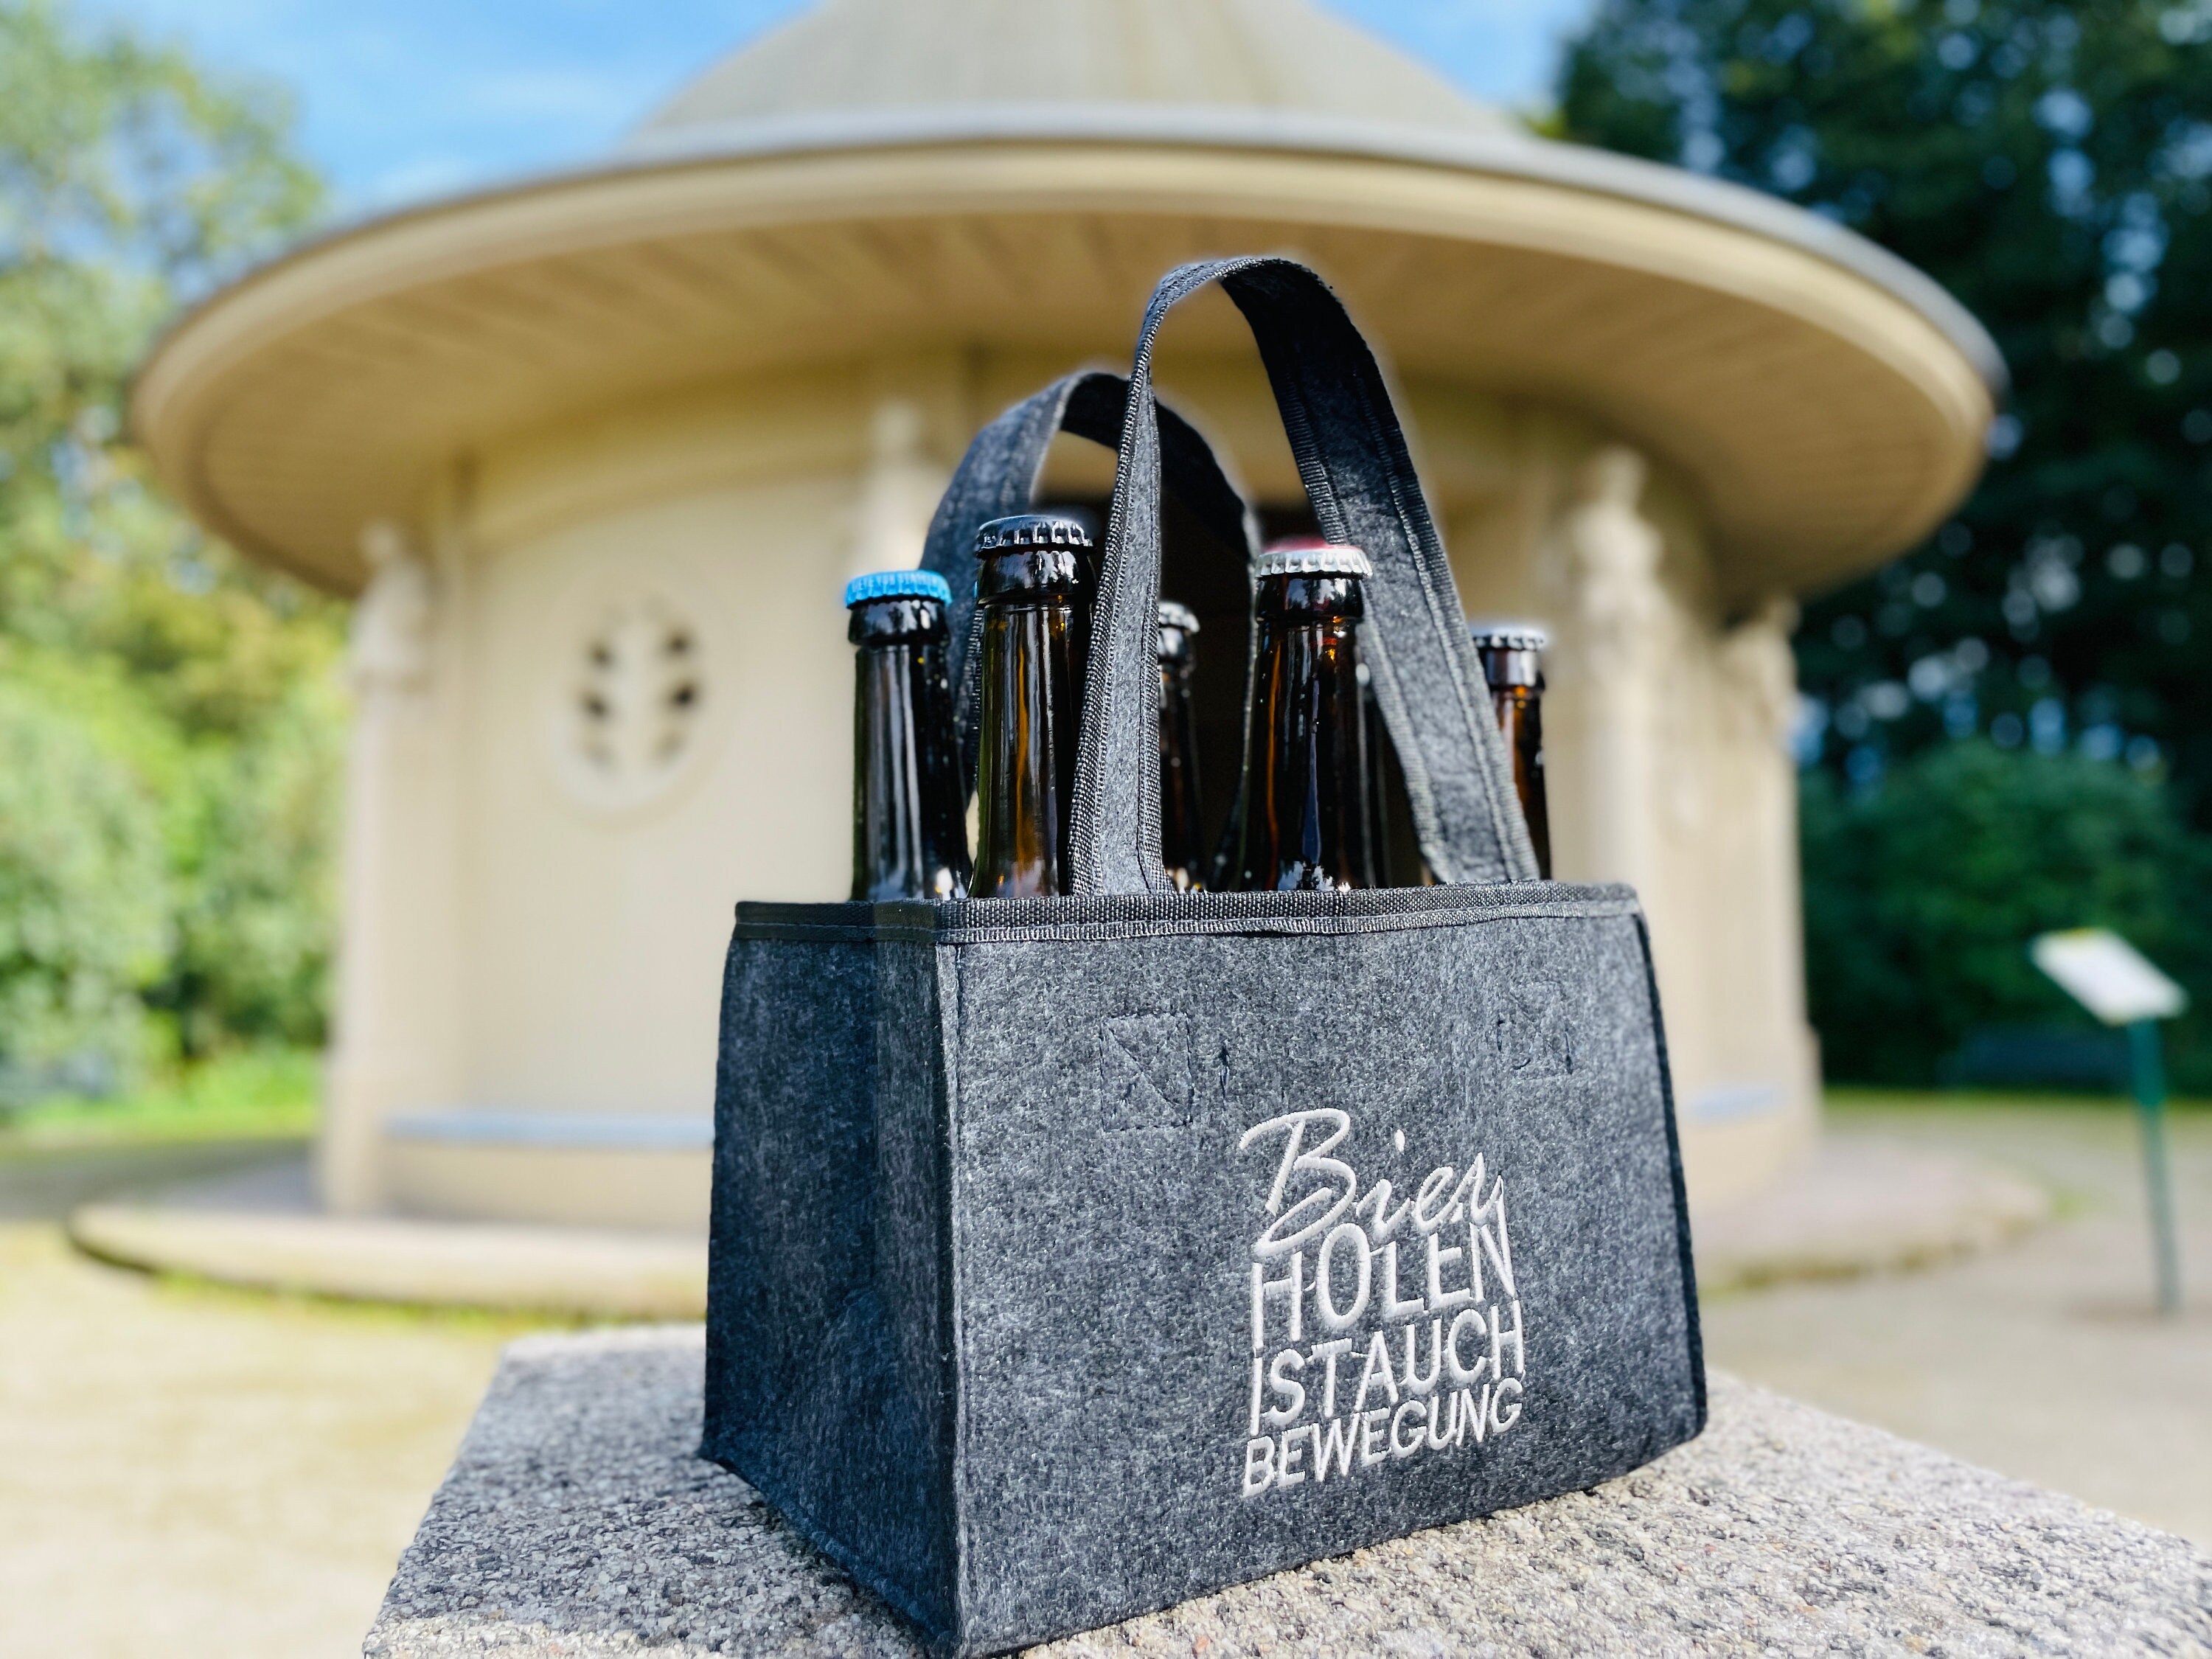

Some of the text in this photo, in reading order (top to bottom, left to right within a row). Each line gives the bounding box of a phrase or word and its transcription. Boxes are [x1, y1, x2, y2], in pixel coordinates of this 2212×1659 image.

[1239, 1107, 1504, 1255] Bier
[1252, 1222, 1516, 1349] HOLEN
[1250, 1300, 1524, 1436] IST AUCH
[1243, 1377, 1523, 1498] BEWEGUNG
